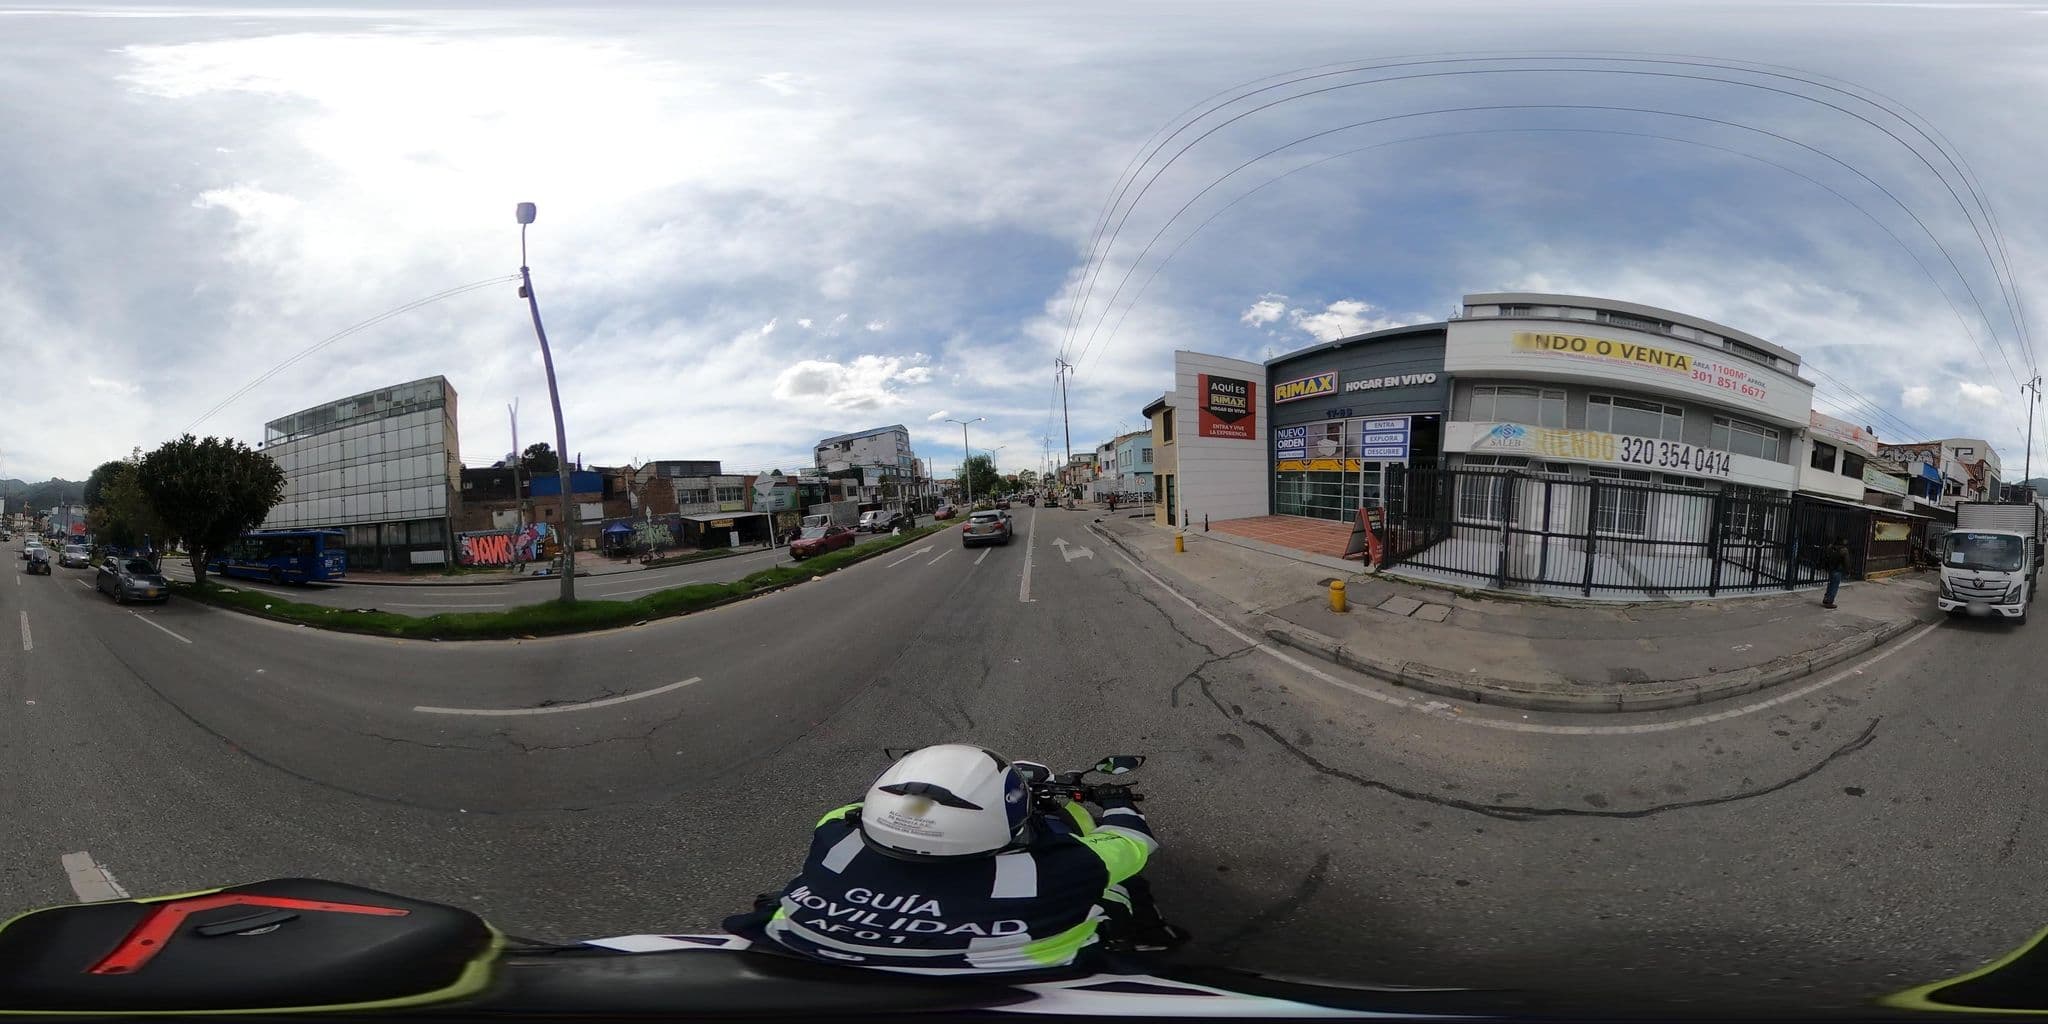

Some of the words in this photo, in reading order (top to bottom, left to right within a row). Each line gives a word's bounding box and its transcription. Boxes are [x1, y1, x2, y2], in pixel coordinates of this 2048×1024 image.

[1596, 340, 1612, 355] O
[1621, 343, 1688, 370] VENTA
[1211, 382, 1234, 393] AQUÍ
[1235, 386, 1246, 394] ES
[1276, 375, 1332, 400] RIMAX
[1345, 378, 1382, 392] HOGAR
[1384, 376, 1399, 387] EN
[1401, 373, 1437, 385] VIVO
[1691, 369, 1712, 383] 301
[1717, 377, 1737, 390] 851
[1741, 384, 1766, 399] 6677
[1212, 395, 1244, 406] RIMAX
[1374, 421, 1395, 429] ENTRA
[1278, 427, 1304, 438] NUEVO
[1370, 433, 1398, 442] EXPLORA
[1278, 438, 1304, 449] ORDEN
[1367, 447, 1401, 456] DESCUBRE
[1621, 436, 1653, 464] 320
[1659, 443, 1690, 469] 354
[1695, 448, 1730, 477] 0414
[845, 887, 942, 917] GUÍA
[790, 885, 1030, 936] MOVILIDAD
